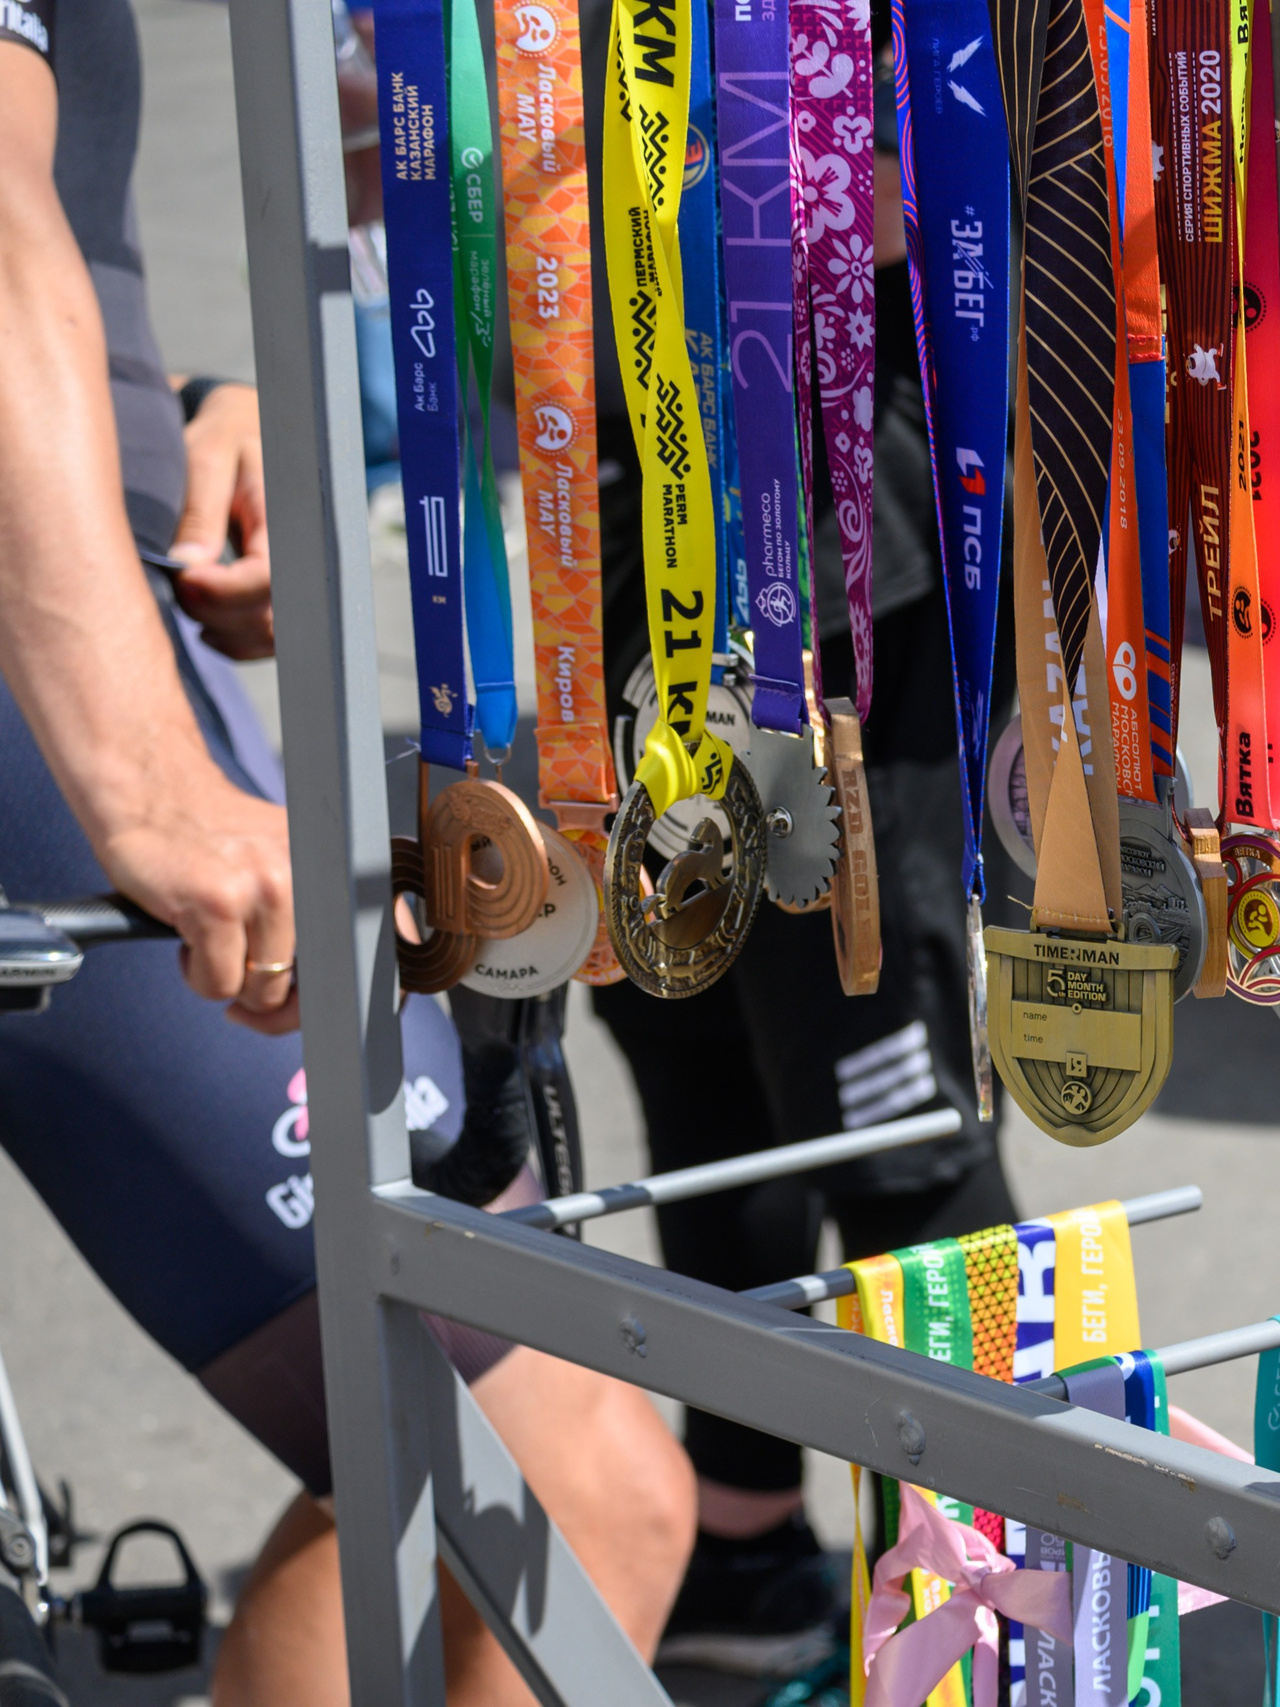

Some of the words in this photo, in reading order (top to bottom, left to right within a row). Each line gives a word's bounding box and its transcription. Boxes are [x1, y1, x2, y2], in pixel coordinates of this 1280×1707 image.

[392, 72, 404, 109] БАНК
[1176, 51, 1188, 114] СОБЫТИЙ
[1199, 50, 1221, 115] 2020
[394, 111, 408, 157] БАРС
[406, 85, 422, 181] КАЗАНСКИЙ
[422, 105, 437, 181] МАРАФОН
[516, 93, 537, 143] MAY
[537, 63, 558, 173] Ласковый
[395, 160, 408, 181] АК
[1180, 116, 1193, 201] СПОРТИВНЫХ
[1201, 120, 1223, 243] ШИЖМА
[466, 173, 484, 224] СБЕР
[1184, 203, 1194, 242] СЕРИЯ
[628, 206, 648, 288] ПЕРМСКИЙ
[535, 256, 559, 320] 2023
[732, 300, 793, 393] 21
[1116, 408, 1129, 530] 23.09.2018
[1238, 419, 1248, 493] 2021
[536, 489, 557, 538] MAY
[555, 461, 578, 569] Ласковый
[662, 483, 678, 569] MARATHON
[675, 483, 688, 526] PERM
[761, 492, 778, 577] pharmeco
[963, 505, 983, 591] ПСБ
[1199, 484, 1223, 622] ТРЕЙЛ
[660, 587, 704, 659] 21
[554, 645, 577, 723] Киров
[1130, 708, 1143, 793] АБСОЛЮТ
[1236, 732, 1254, 819] Вятка
[474, 962, 540, 981] САМАРА
[1067, 971, 1089, 982] DAY
[1067, 981, 1105, 993] MONTH
[1067, 991, 1107, 1002] EDITION
[1022, 1011, 1048, 1022] name
[1022, 1033, 1044, 1044] time
[928, 1313, 955, 1364] ЕГИ,
[1082, 1282, 1109, 1344] БЕГИ,
